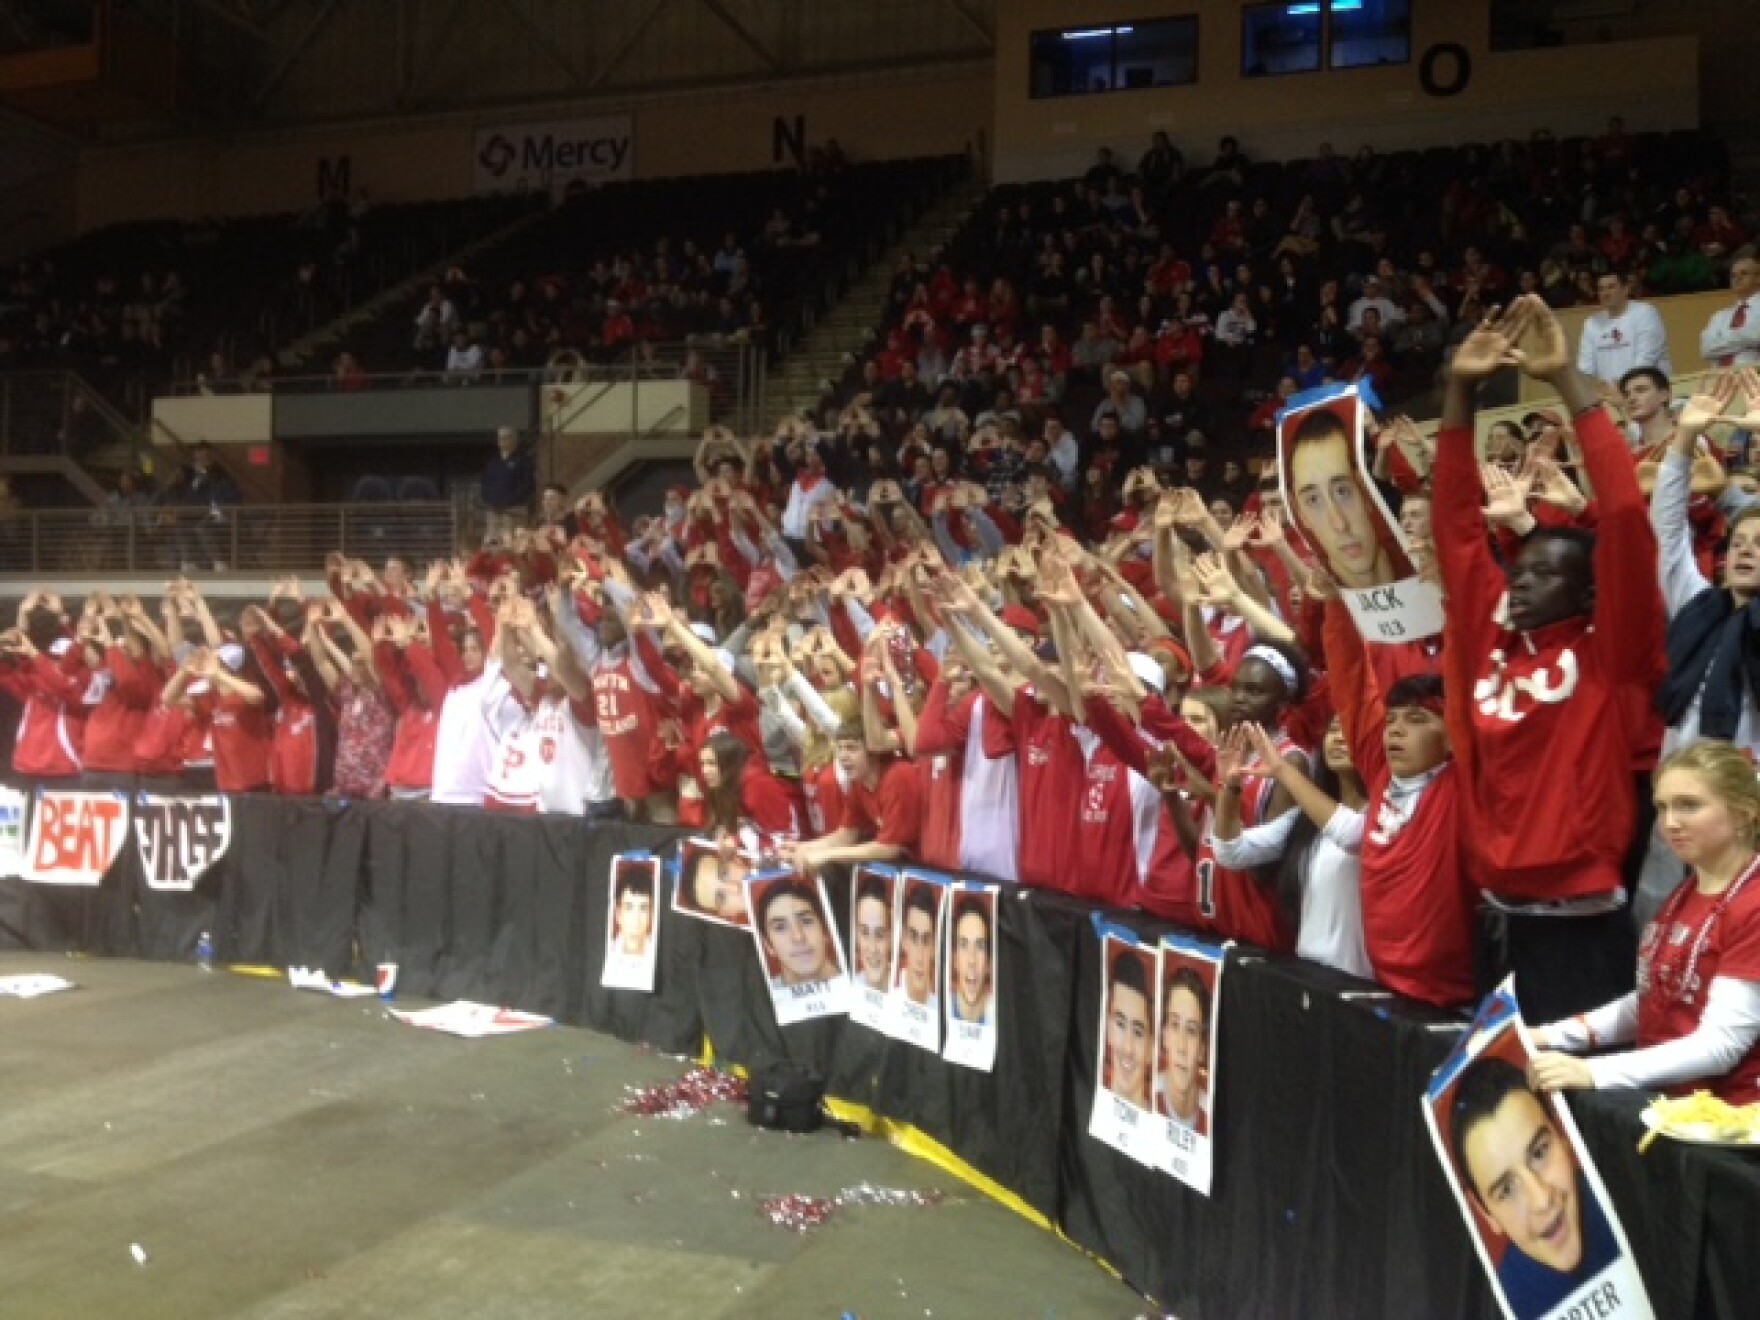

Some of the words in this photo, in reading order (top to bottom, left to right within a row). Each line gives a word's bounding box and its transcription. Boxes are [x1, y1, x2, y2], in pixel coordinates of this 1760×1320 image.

[1419, 43, 1471, 97] O
[522, 132, 630, 171] Mercy
[773, 114, 806, 163] N
[318, 155, 351, 198] M
[33, 798, 121, 872] BEAT
